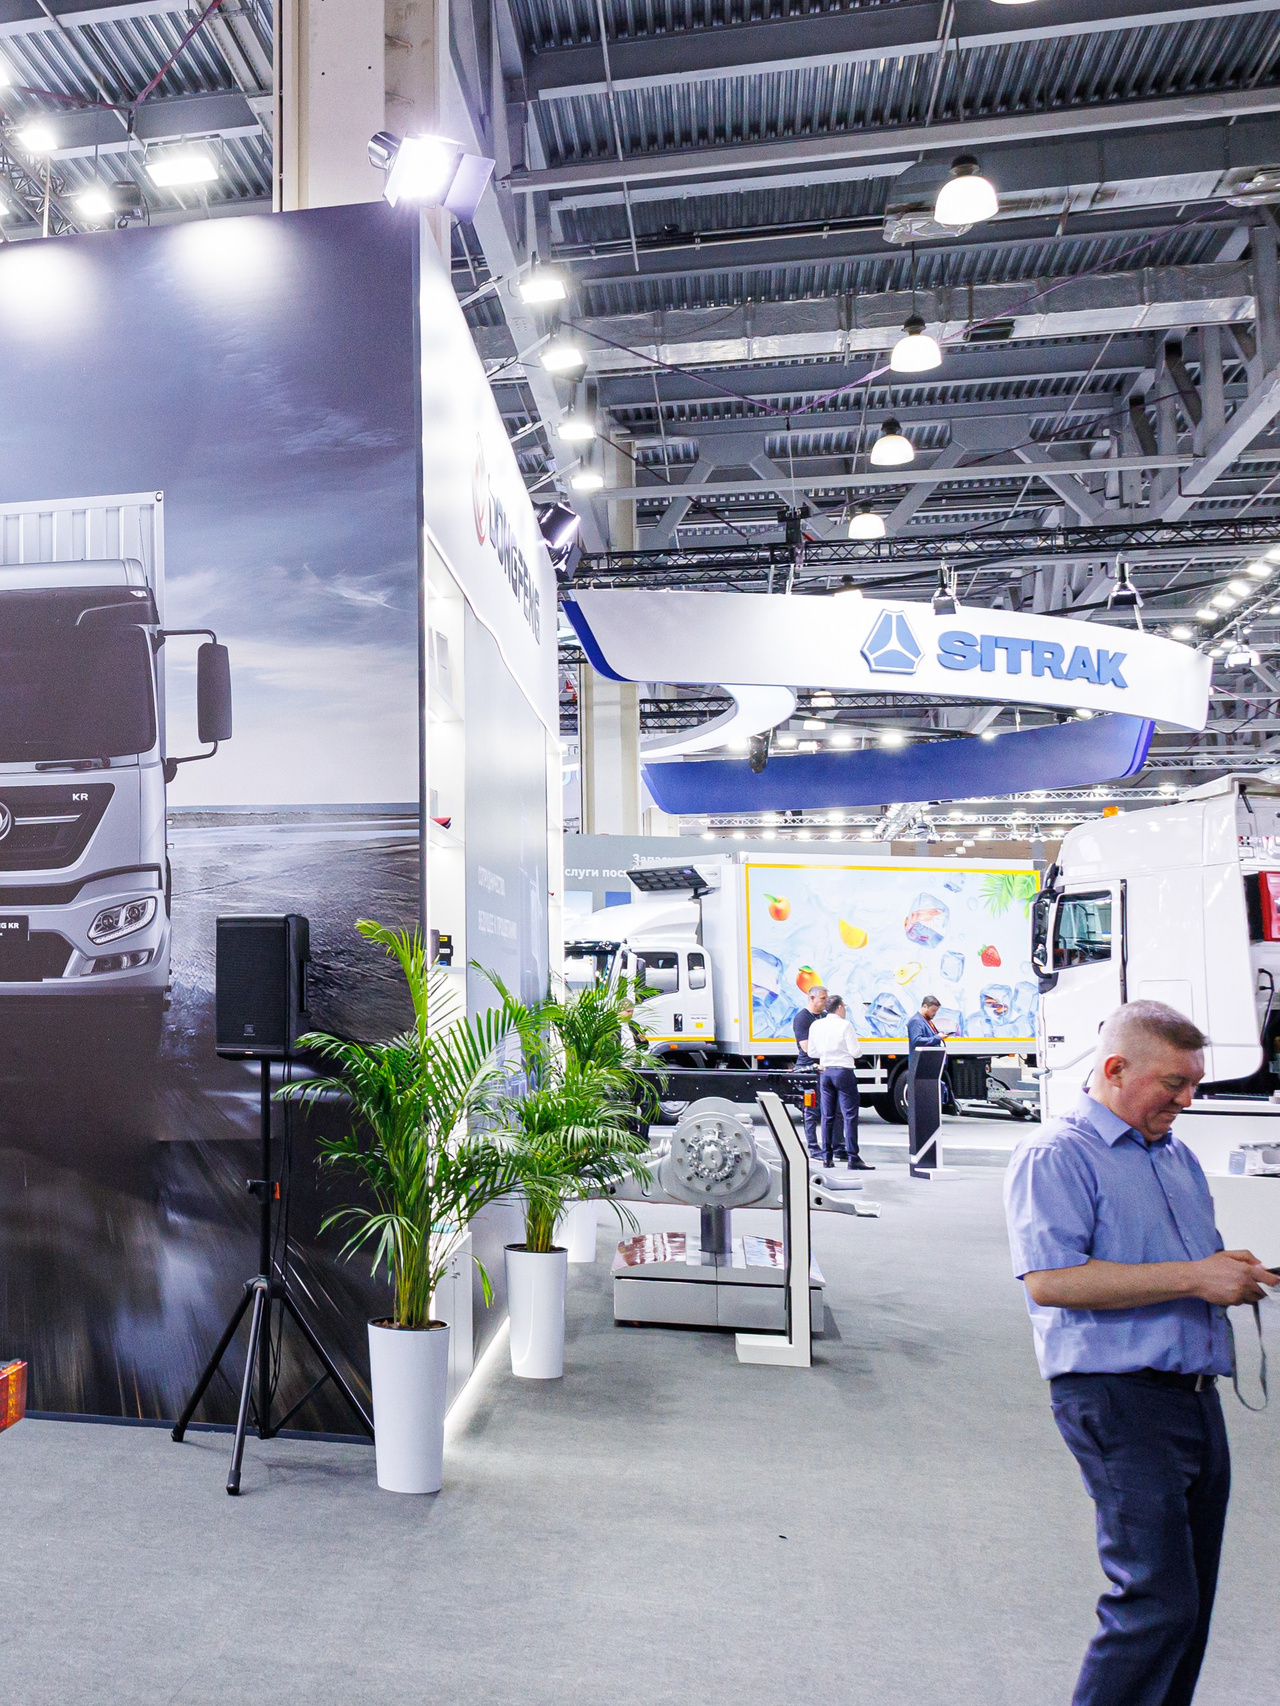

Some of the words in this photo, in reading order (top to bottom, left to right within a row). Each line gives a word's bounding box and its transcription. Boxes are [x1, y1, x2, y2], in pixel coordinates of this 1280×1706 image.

[936, 630, 1129, 689] SITRAK
[72, 793, 89, 801] KR
[602, 869, 627, 878] пос
